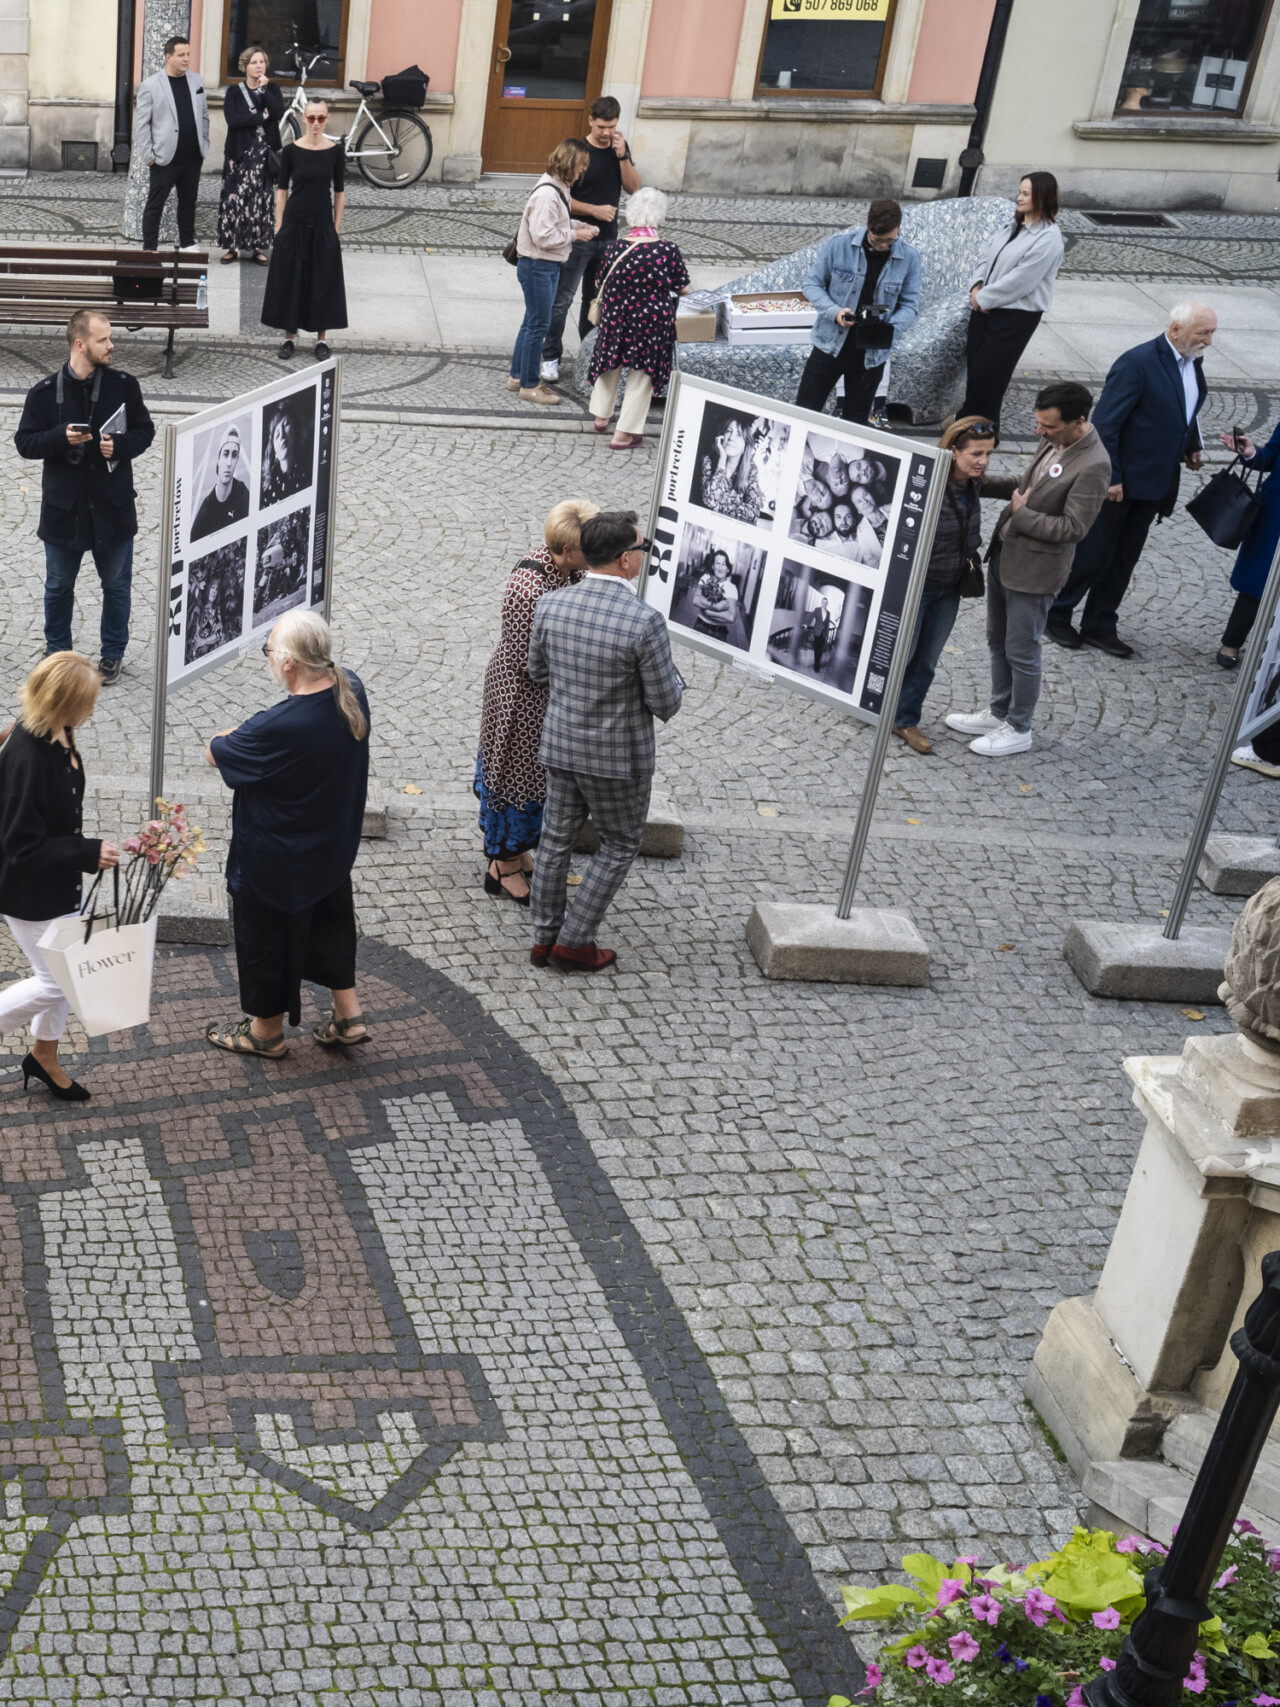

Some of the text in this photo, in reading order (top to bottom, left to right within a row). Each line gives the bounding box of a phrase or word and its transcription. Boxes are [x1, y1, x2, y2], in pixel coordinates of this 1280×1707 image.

[830, 0, 853, 11] 869
[856, 0, 878, 11] 068
[667, 428, 685, 502] portretów
[173, 477, 182, 555] portretów
[78, 949, 136, 978] Flower
